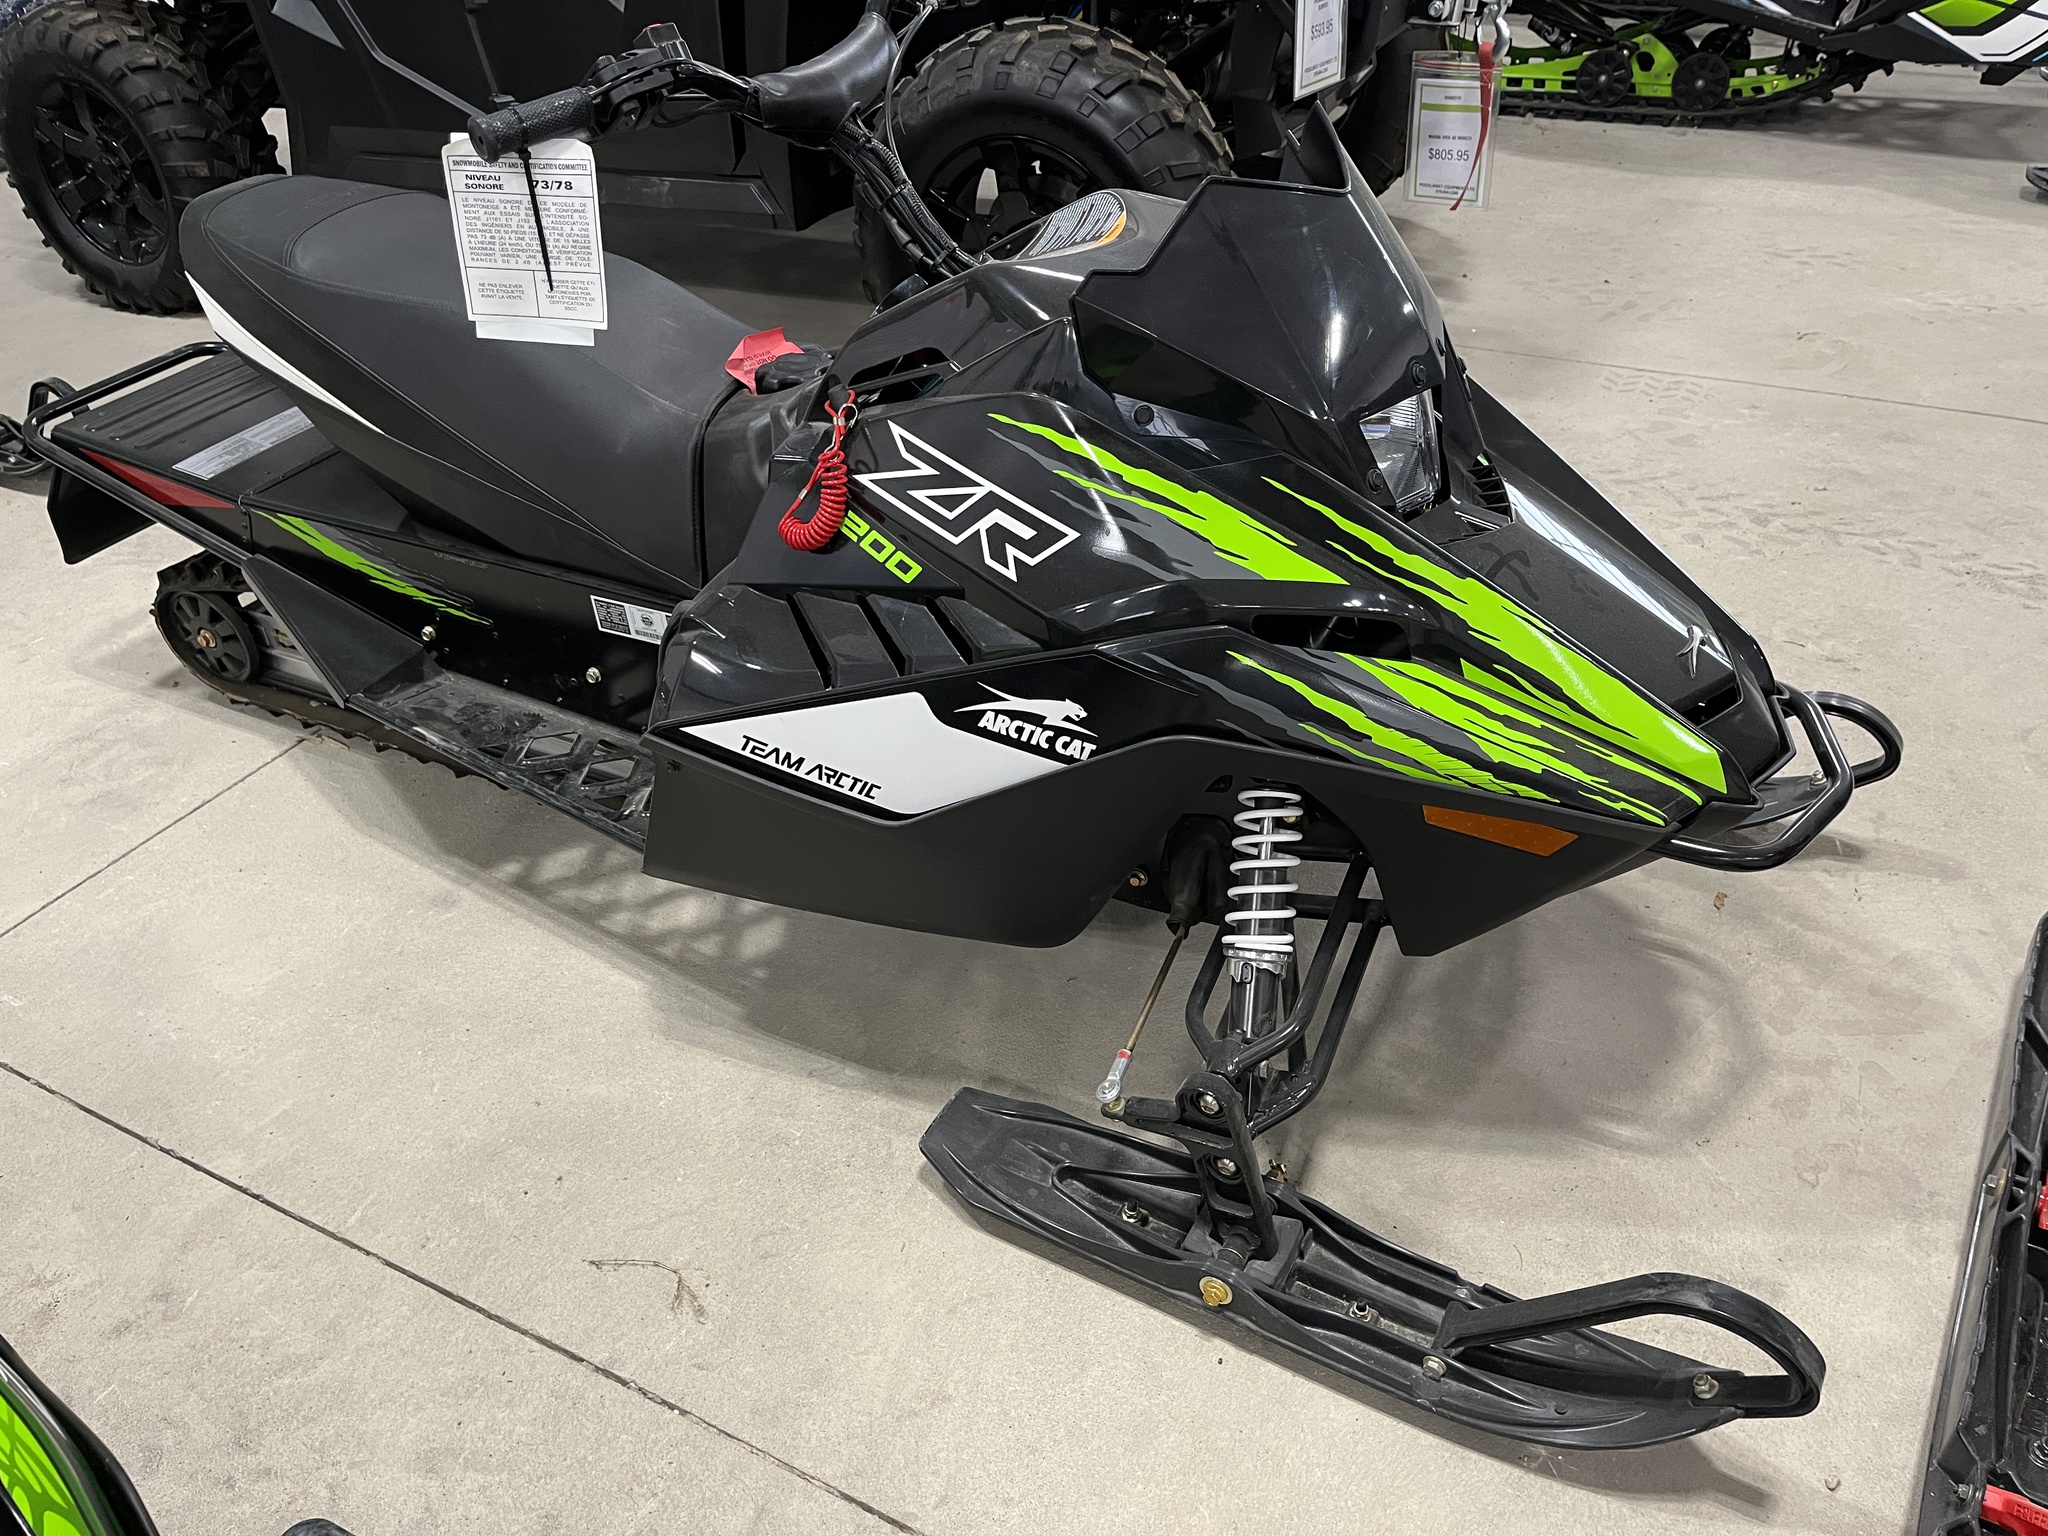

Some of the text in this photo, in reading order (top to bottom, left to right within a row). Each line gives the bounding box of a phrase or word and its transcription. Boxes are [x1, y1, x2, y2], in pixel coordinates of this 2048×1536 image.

[1428, 148, 1469, 162] $805.95
[532, 180, 573, 190] 73/78
[852, 419, 1081, 582] ZR
[978, 710, 1098, 762] ARCTIC CAT
[741, 734, 882, 800] TEAM ARCTIC
